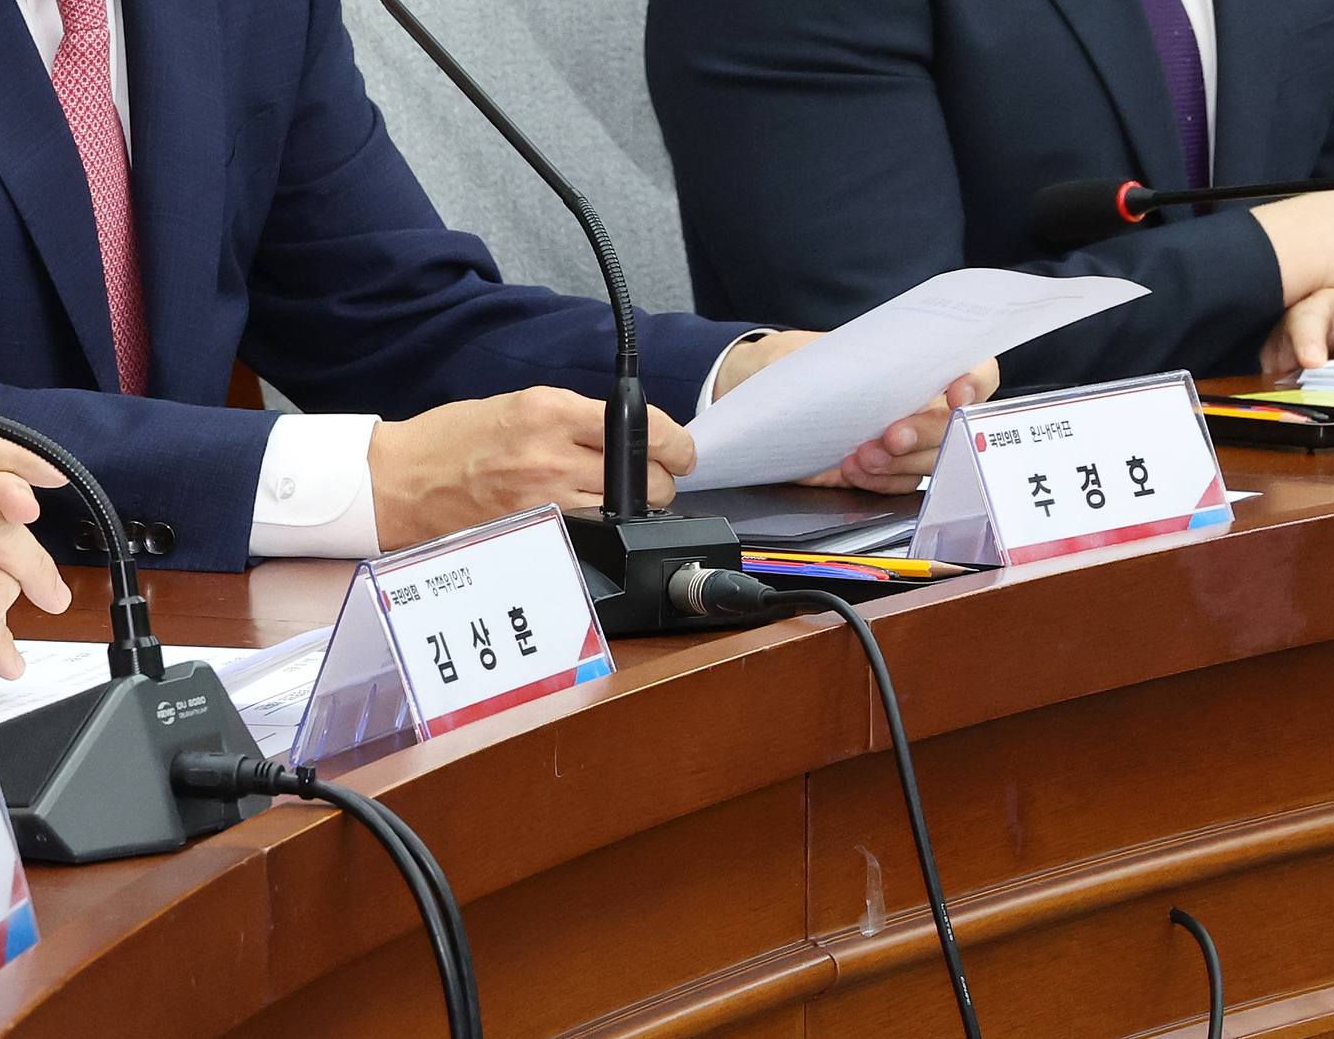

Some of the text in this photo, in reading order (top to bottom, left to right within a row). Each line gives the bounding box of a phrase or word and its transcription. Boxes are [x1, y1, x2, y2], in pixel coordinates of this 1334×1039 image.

[988, 420, 1074, 448] 국민의힘 원내대표
[390, 566, 473, 606] 국민의힘 정책위의장
